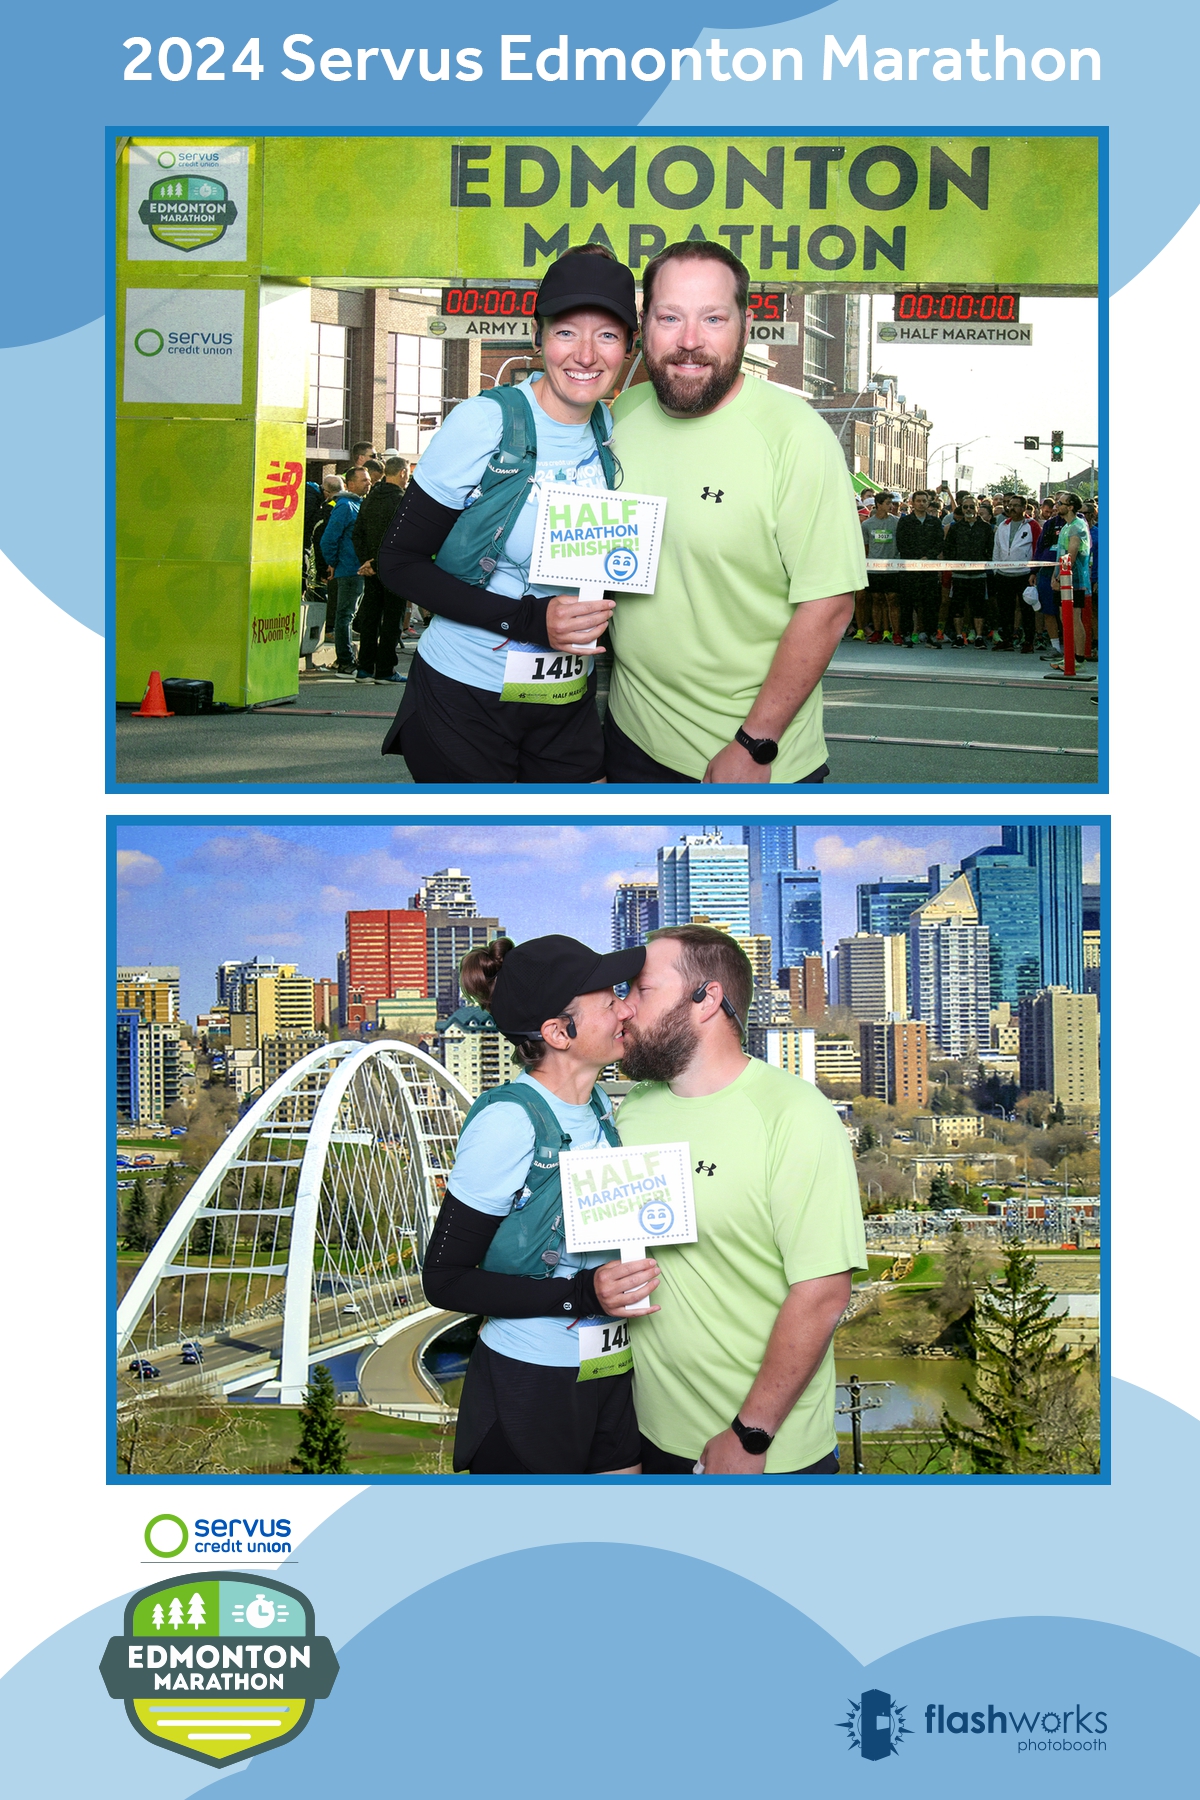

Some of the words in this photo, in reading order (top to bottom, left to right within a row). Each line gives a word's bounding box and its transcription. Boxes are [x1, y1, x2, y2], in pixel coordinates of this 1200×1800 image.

[178, 152, 219, 161] servus
[450, 144, 990, 210] EDMONTON
[149, 203, 226, 214] EDMONTON
[160, 214, 215, 222] MARATHON
[168, 332, 233, 345] servus
[466, 321, 518, 335] ARMY
[522, 322, 530, 335] 1
[900, 328, 939, 340] HALF
[943, 328, 1031, 341] MARATHON
[168, 345, 200, 355] credit
[203, 347, 232, 355] union
[549, 500, 638, 529] HALF
[550, 524, 639, 543] MARATHON
[550, 537, 640, 559] FINISHER!
[257, 613, 290, 643] Running
[532, 655, 583, 680] 1415
[571, 1151, 662, 1197] HALF
[577, 1174, 667, 1210] MARATHON
[580, 1187, 673, 1226] FINISHER!
[602, 1323, 630, 1353] 141
